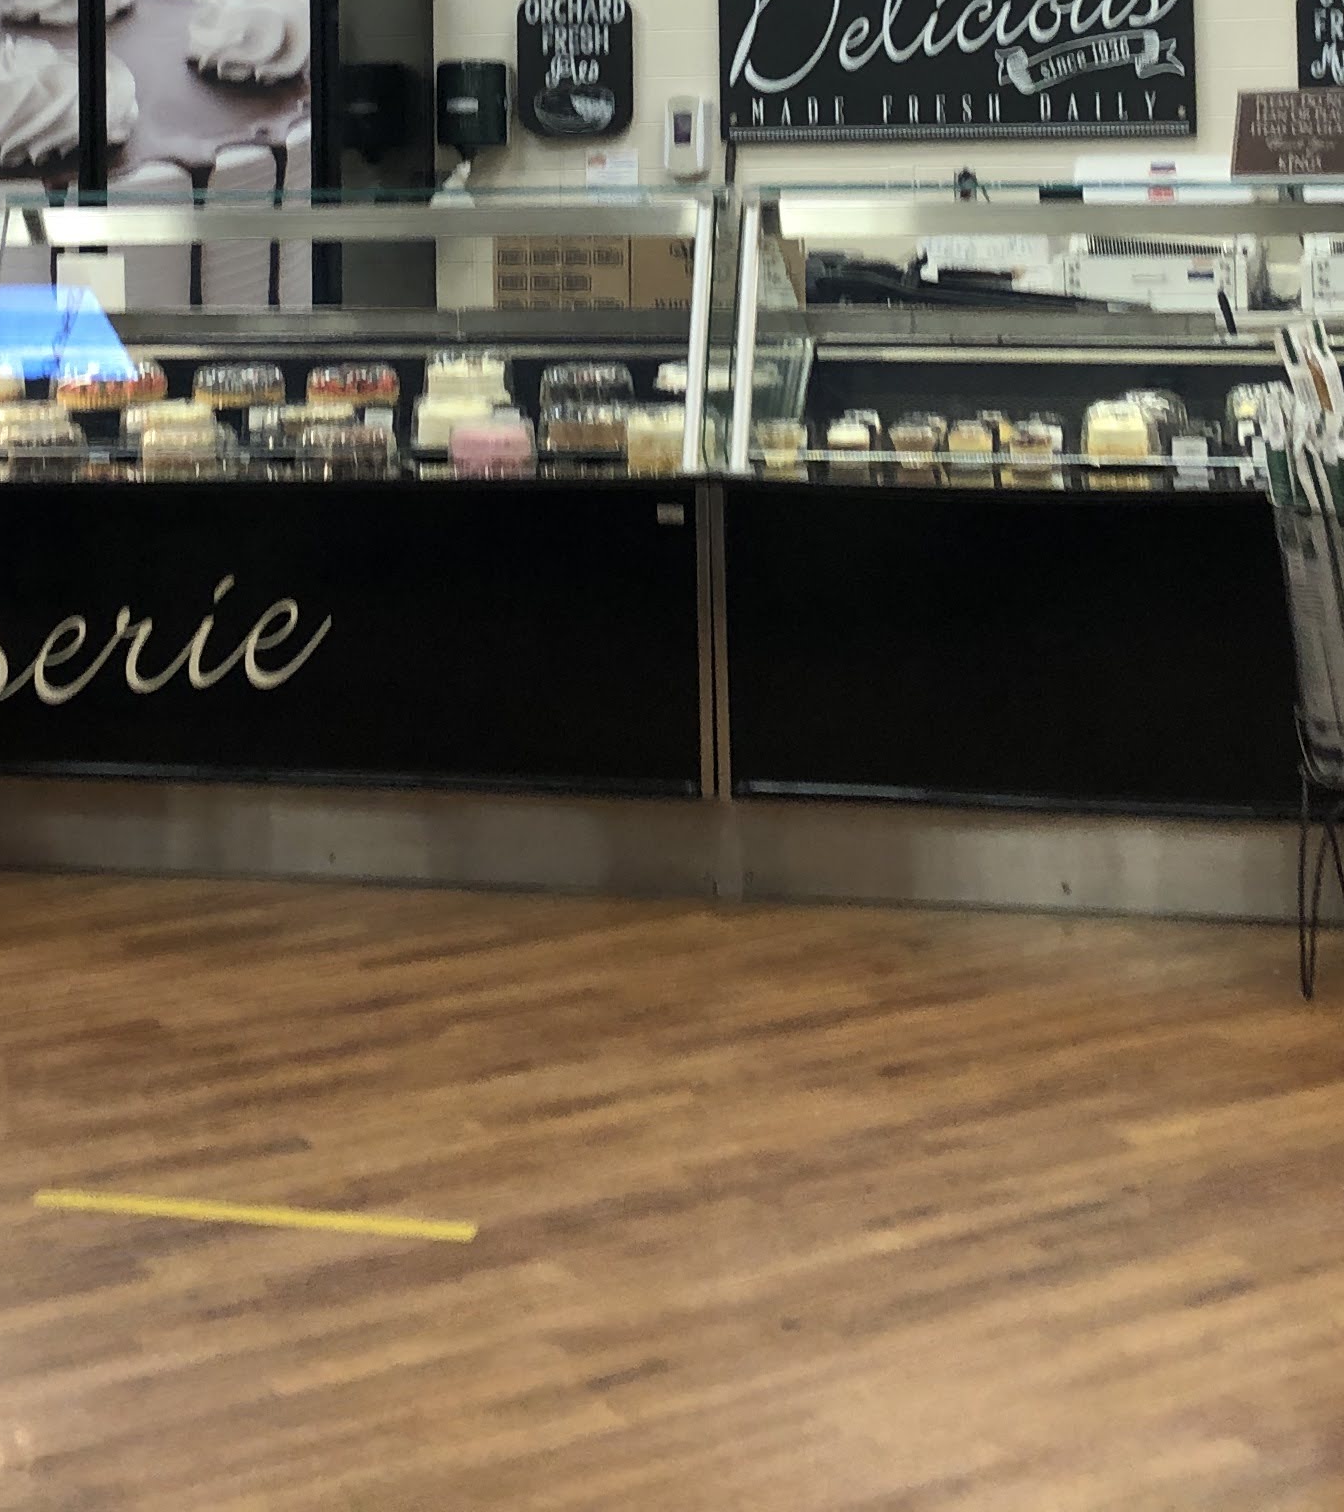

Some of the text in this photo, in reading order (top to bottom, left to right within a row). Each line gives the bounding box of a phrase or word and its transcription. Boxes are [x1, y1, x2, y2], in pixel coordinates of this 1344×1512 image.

[541, 23, 609, 57] FRESH
[752, 91, 1157, 126] MADE FRESH DAILY
